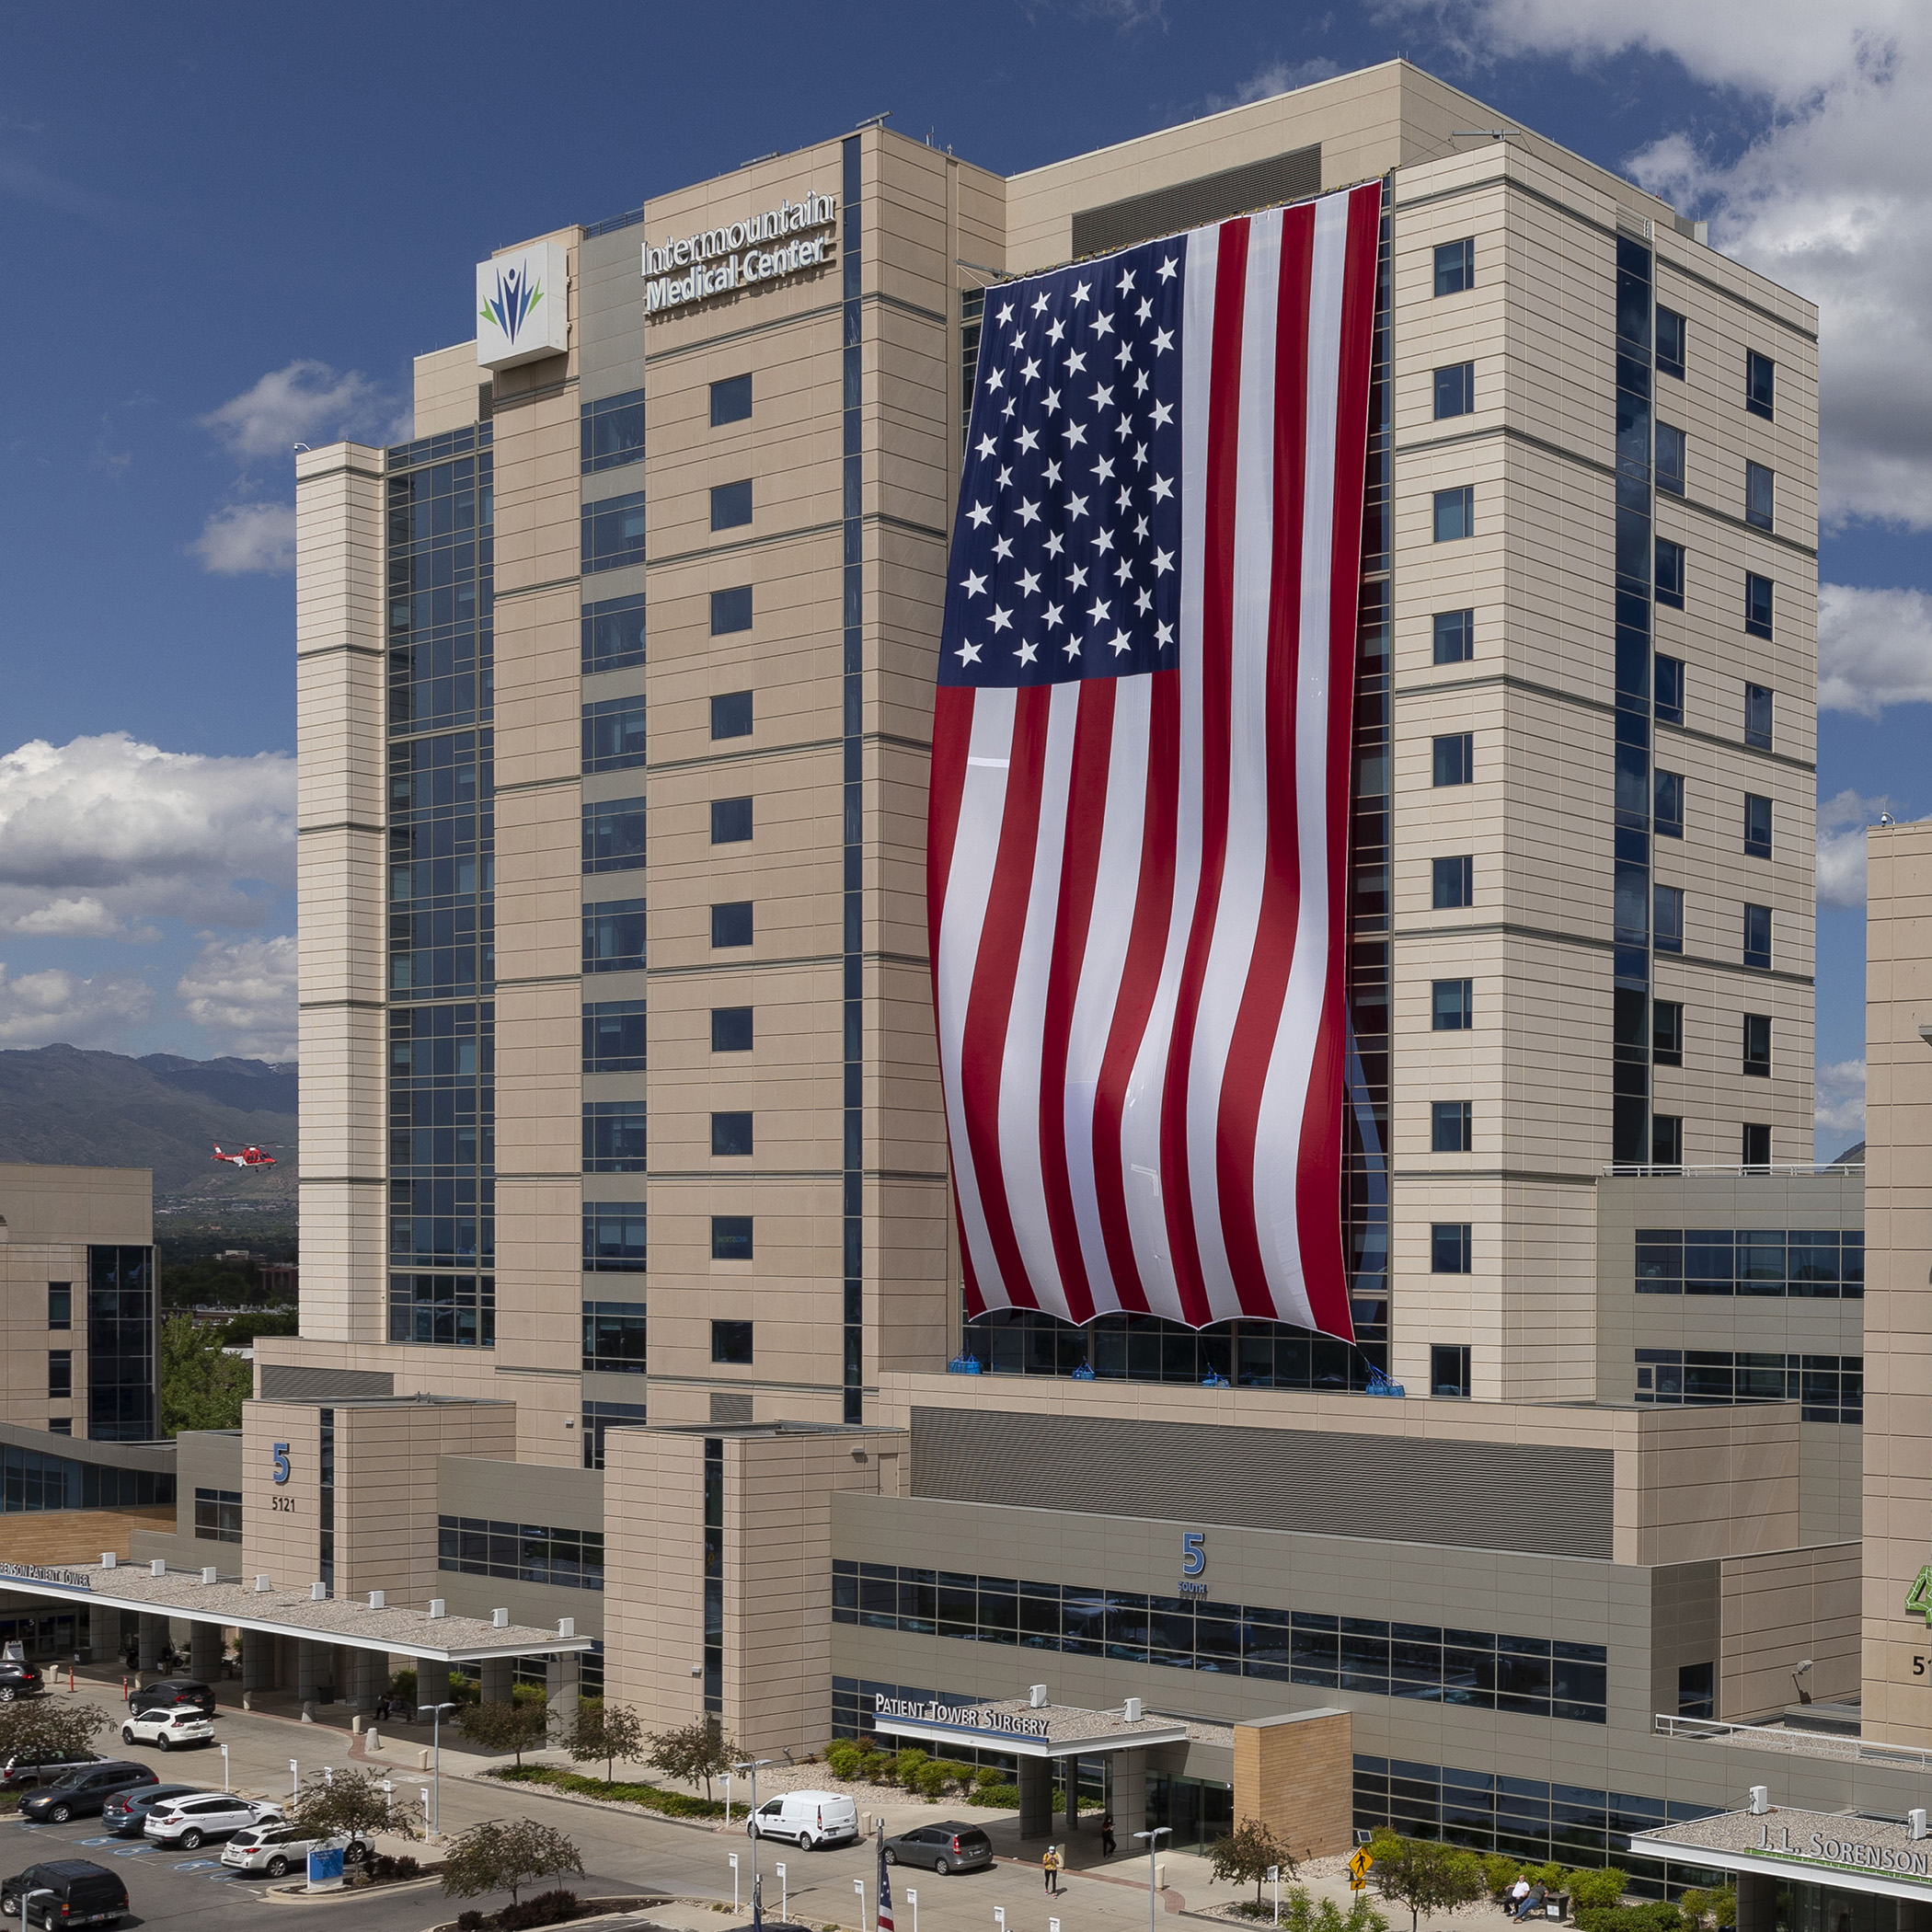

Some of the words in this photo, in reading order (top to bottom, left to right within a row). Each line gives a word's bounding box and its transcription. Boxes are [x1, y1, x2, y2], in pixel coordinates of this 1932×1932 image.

[640, 190, 834, 278] Intermountain
[646, 254, 740, 313] Medical
[743, 235, 829, 283] Center
[272, 1443, 289, 1483] 5
[272, 1496, 295, 1512] 5121
[1182, 1532, 1205, 1575] 5
[29, 1564, 61, 1581] PATIENT
[62, 1569, 90, 1587] TOWER
[1178, 1581, 1207, 1594] SOUTH
[876, 1692, 926, 1719] PATIENT
[929, 1700, 980, 1727] TOWER
[983, 1708, 1051, 1737] SURGERY
[1757, 1824, 1774, 1851] J.
[1781, 1827, 1801, 1855] L.
[1810, 1832, 1928, 1876] SORENSON
